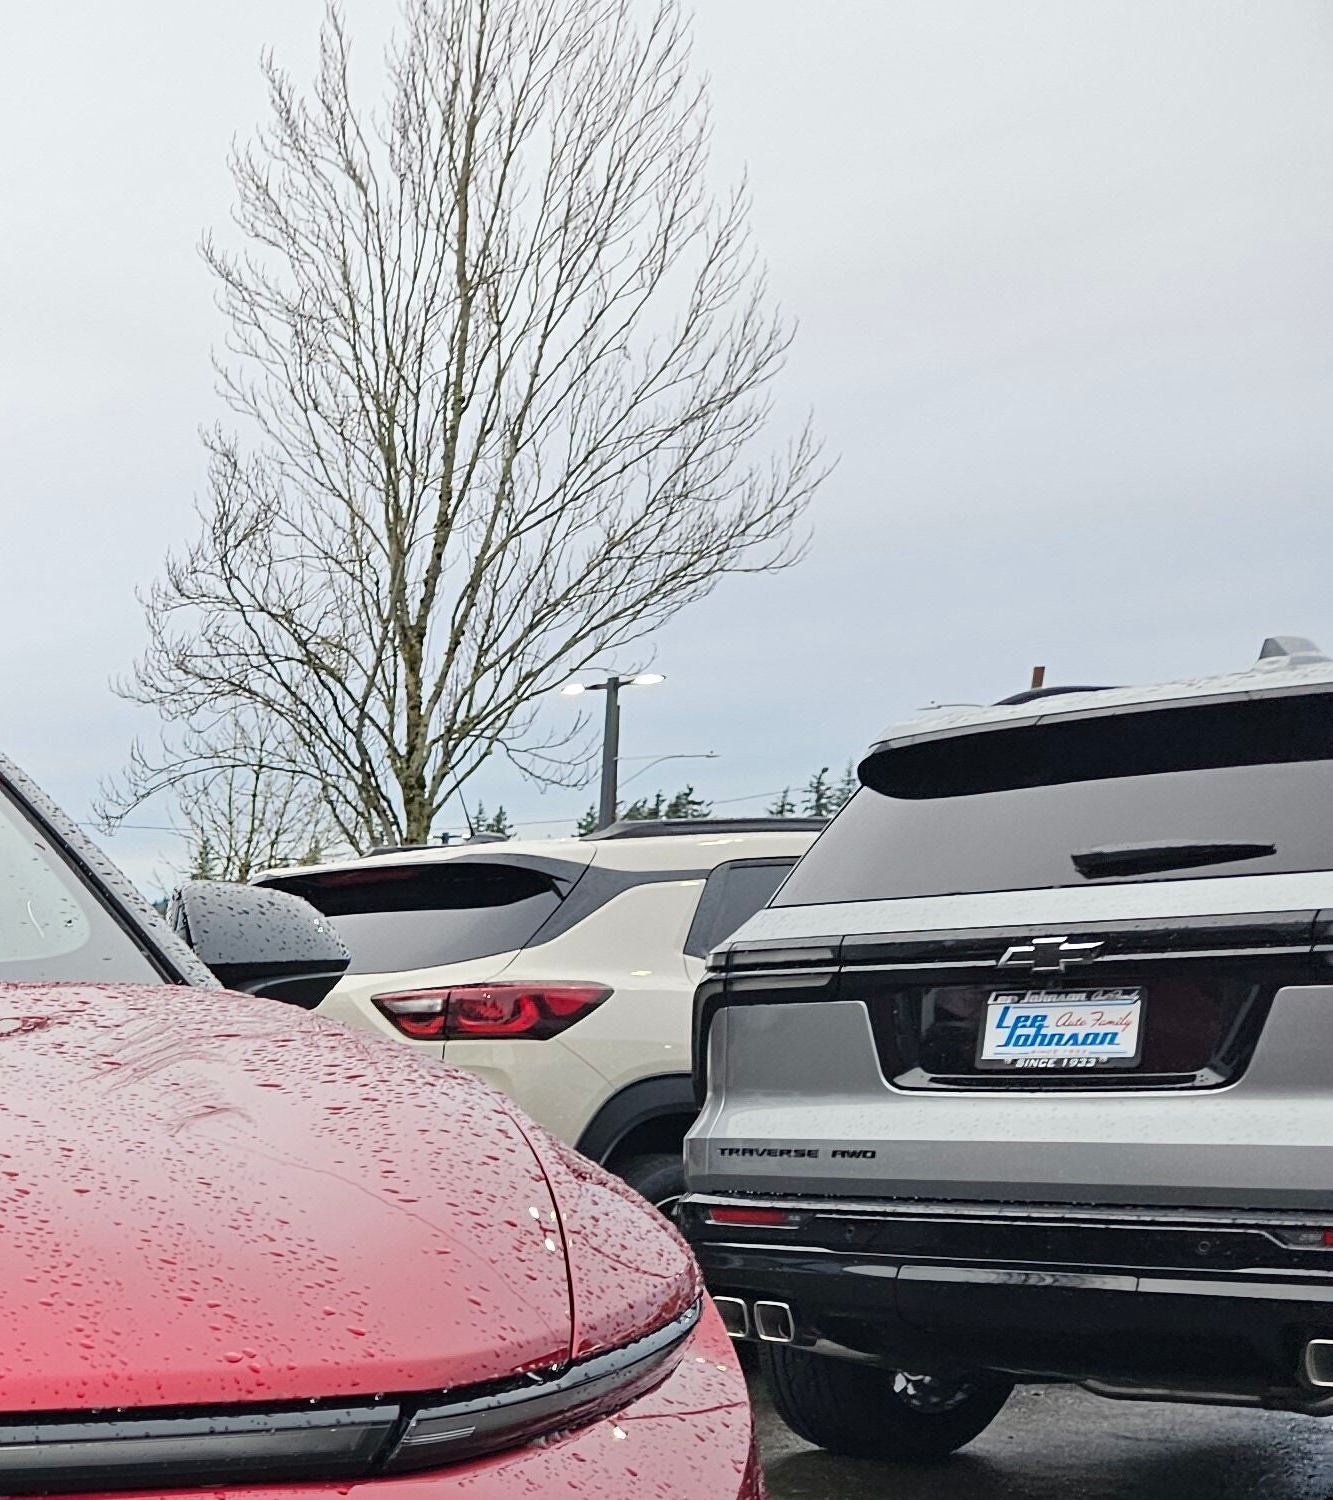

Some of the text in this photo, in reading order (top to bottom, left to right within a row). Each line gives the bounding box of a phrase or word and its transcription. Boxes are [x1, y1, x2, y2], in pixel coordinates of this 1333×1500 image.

[996, 1006, 1133, 1033] Lee Auto Family
[995, 1025, 1121, 1048] Johnson
[1015, 1057, 1098, 1068] SINCE 1933
[718, 1147, 877, 1159] TRAVERSE AWD
